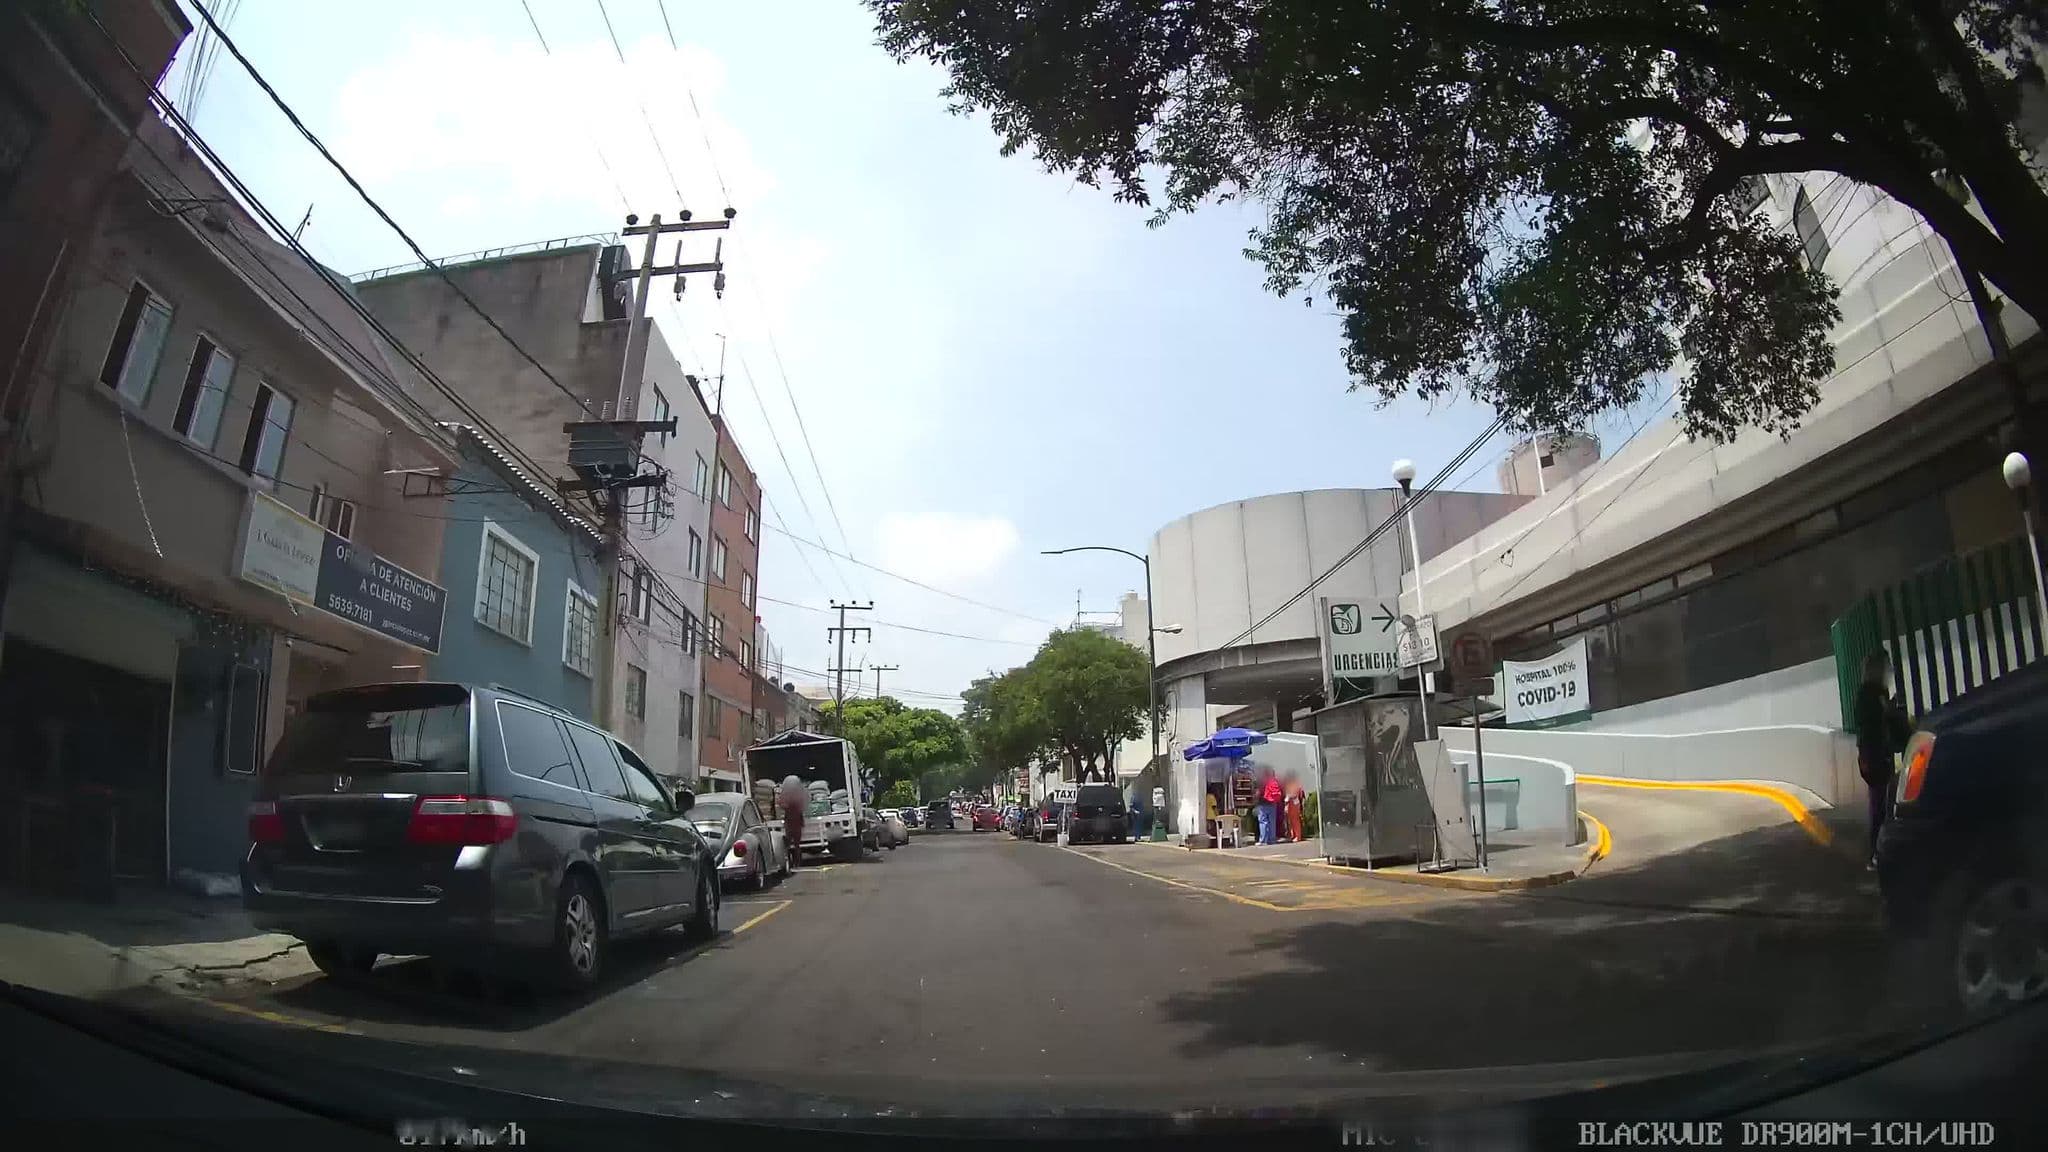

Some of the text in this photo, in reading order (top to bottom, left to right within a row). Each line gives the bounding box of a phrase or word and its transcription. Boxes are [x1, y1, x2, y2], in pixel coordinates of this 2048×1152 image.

[360, 578, 412, 611] A CLIENTES
[379, 565, 392, 582] DE
[393, 575, 436, 602] ATENCIÓN
[1334, 652, 1398, 671] URGENCIAS
[1515, 661, 1576, 685] HOSPITAL 100%
[1518, 681, 1576, 707] COVID-19
[1055, 789, 1076, 798] TAXI
